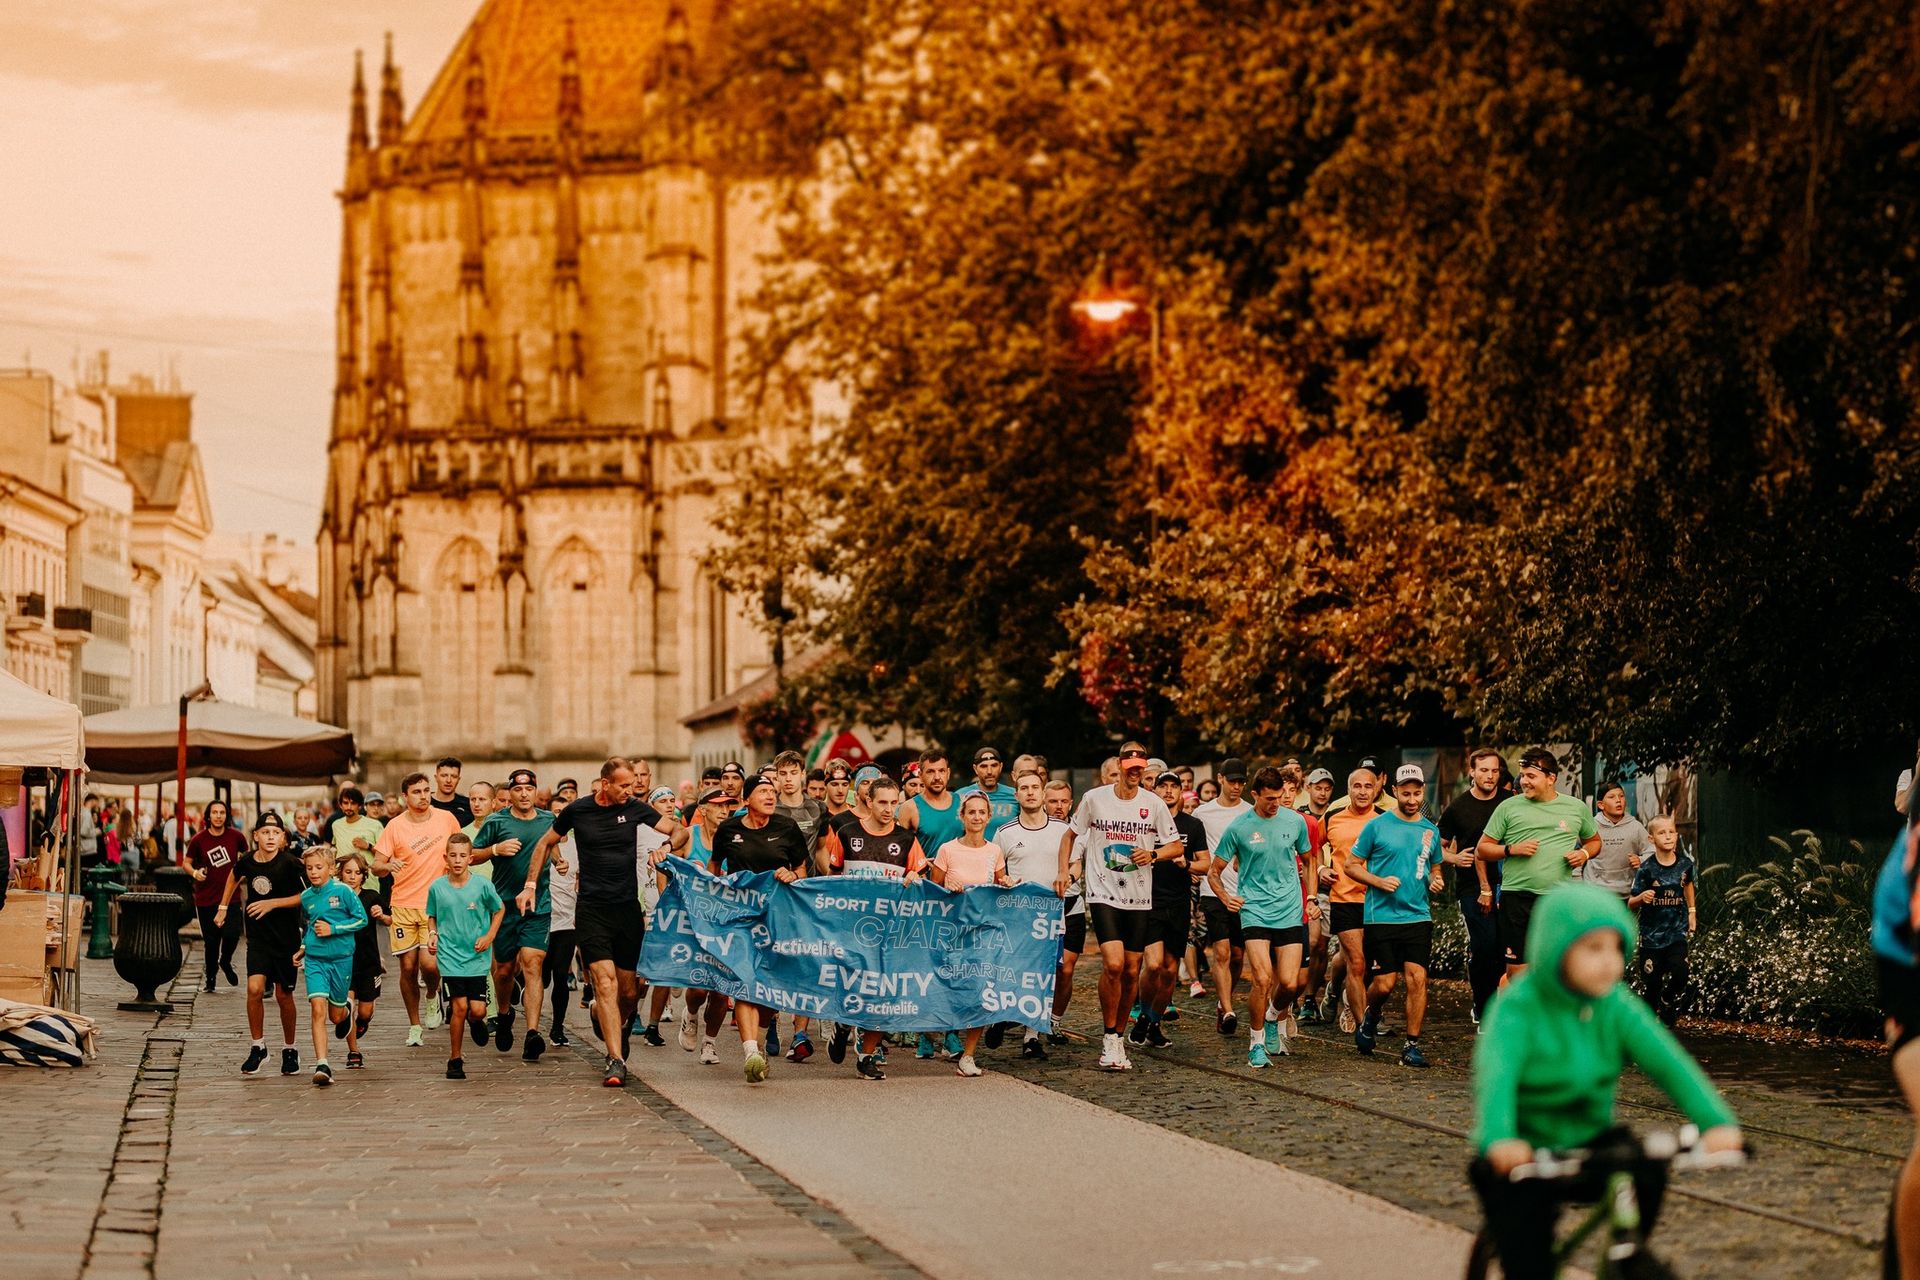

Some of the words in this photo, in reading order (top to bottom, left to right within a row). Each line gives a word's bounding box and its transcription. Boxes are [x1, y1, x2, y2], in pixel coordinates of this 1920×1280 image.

[1106, 832, 1137, 842] RUNNERS
[815, 893, 869, 912] ŠPORT
[874, 897, 954, 917] EVENTY
[853, 915, 1014, 953] CHARITA
[771, 938, 845, 960] activelife
[818, 964, 934, 997] EVENTY
[755, 981, 829, 1014] EVENTY
[866, 1001, 919, 1014] activelife
